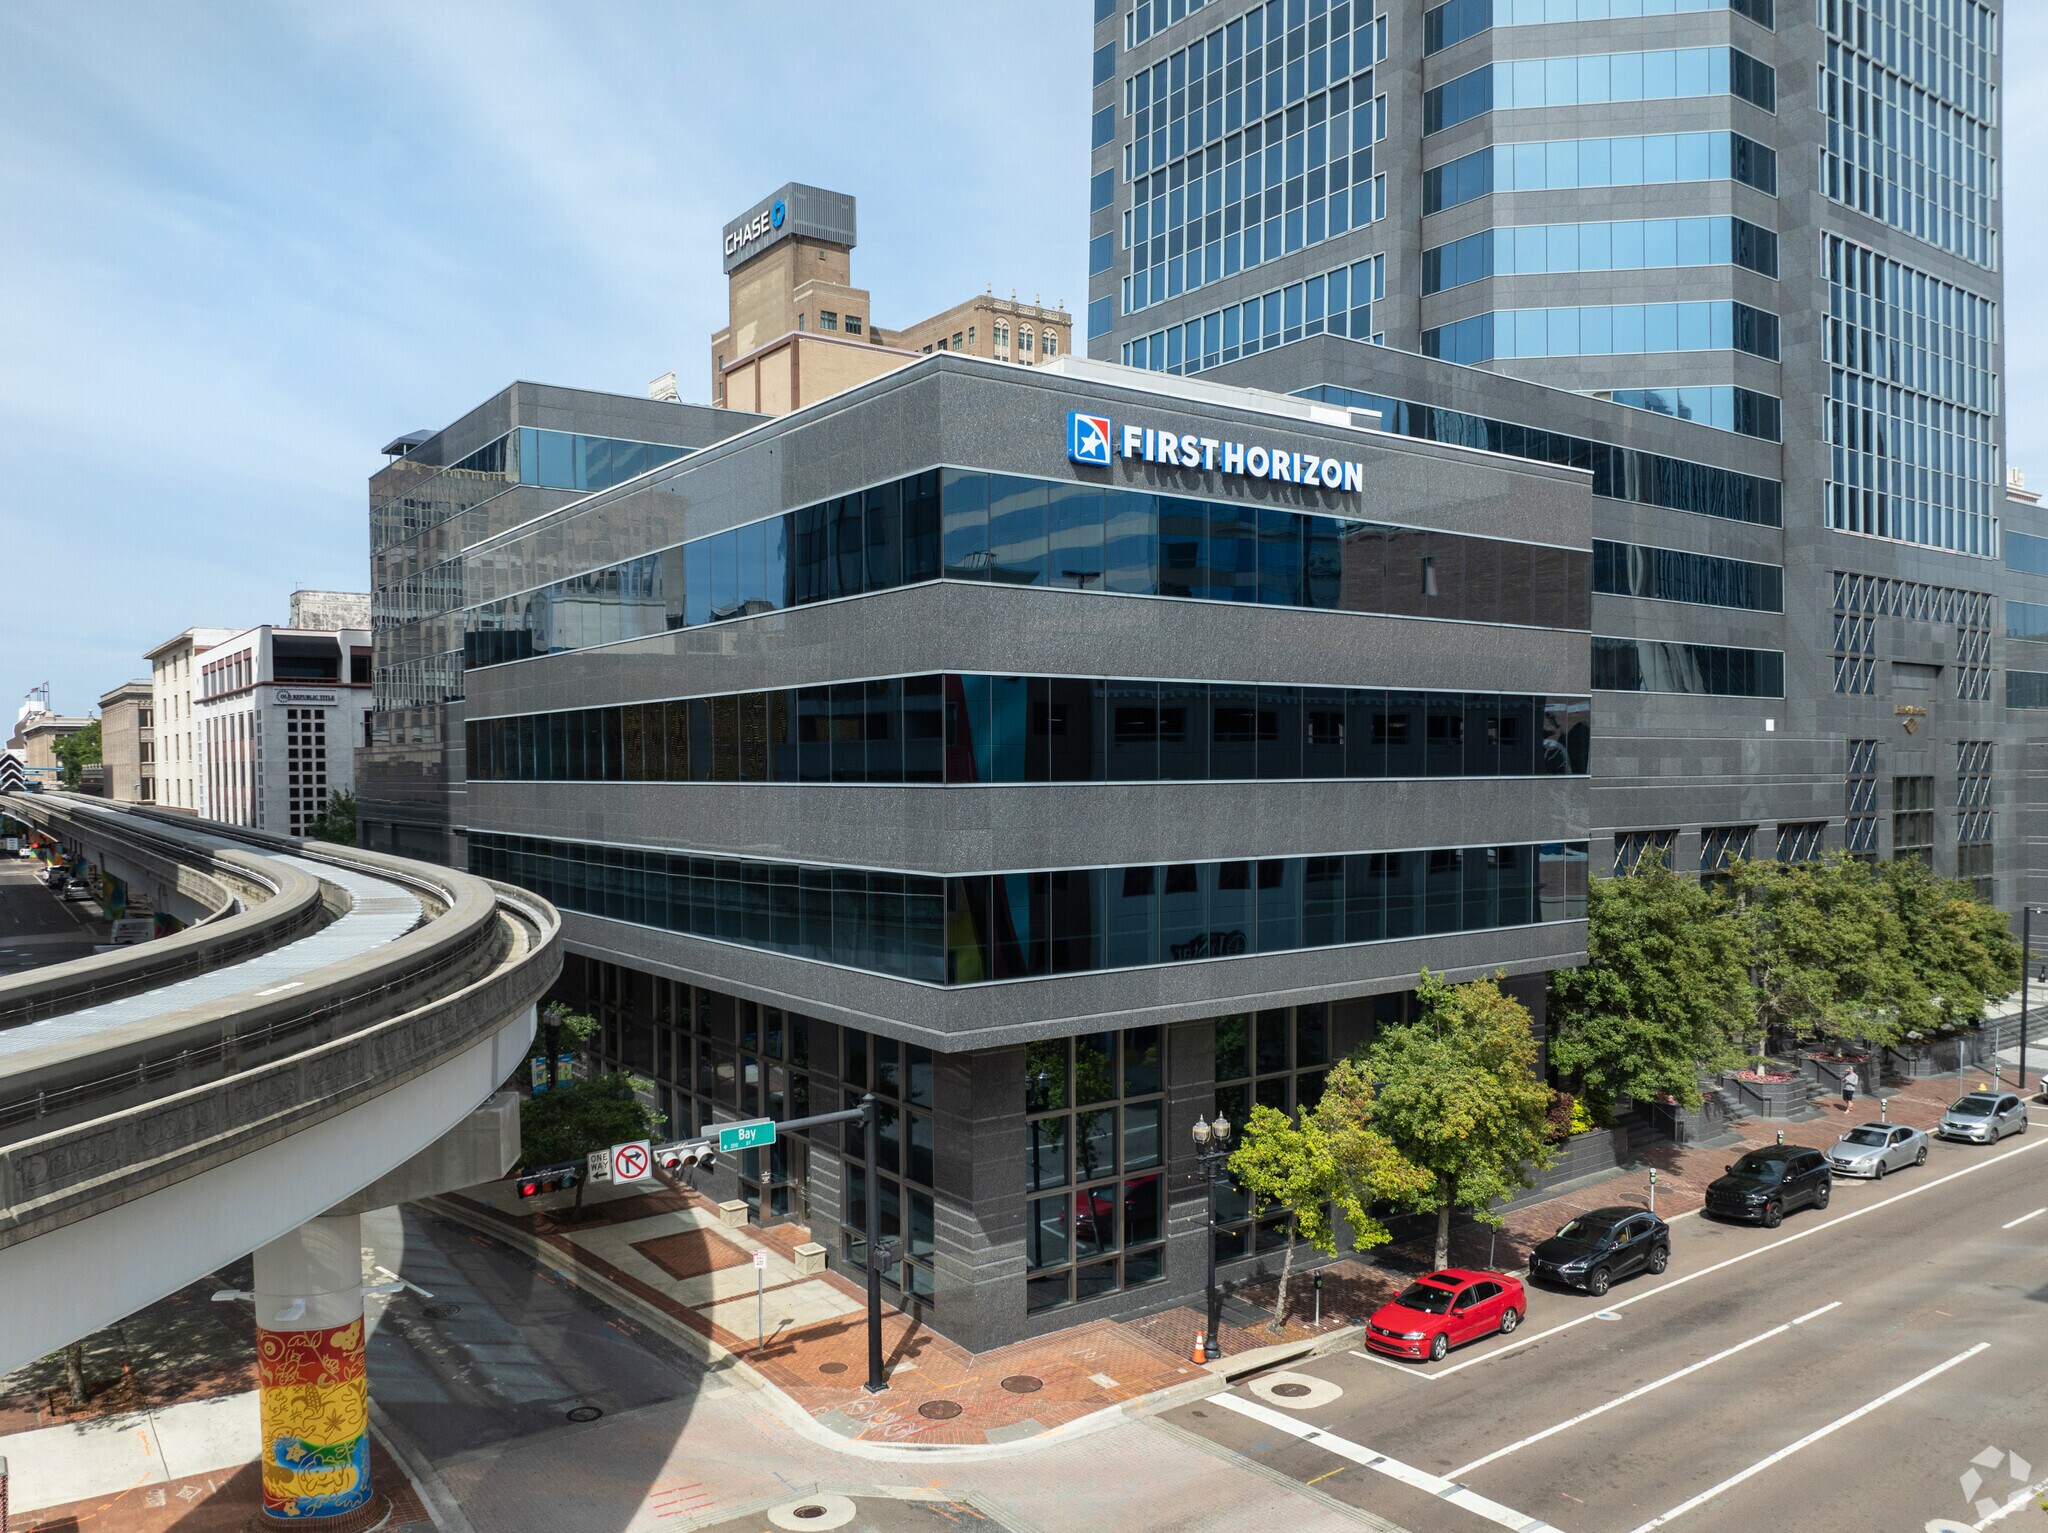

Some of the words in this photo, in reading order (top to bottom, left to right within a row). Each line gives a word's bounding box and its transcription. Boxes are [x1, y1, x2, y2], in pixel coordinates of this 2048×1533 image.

[725, 209, 771, 256] CHASE
[1120, 424, 1219, 471] FIRST
[1221, 441, 1363, 493] HORIZON
[738, 1128, 757, 1141] Bay
[590, 1152, 608, 1163] ONE
[591, 1161, 609, 1171] WAY
